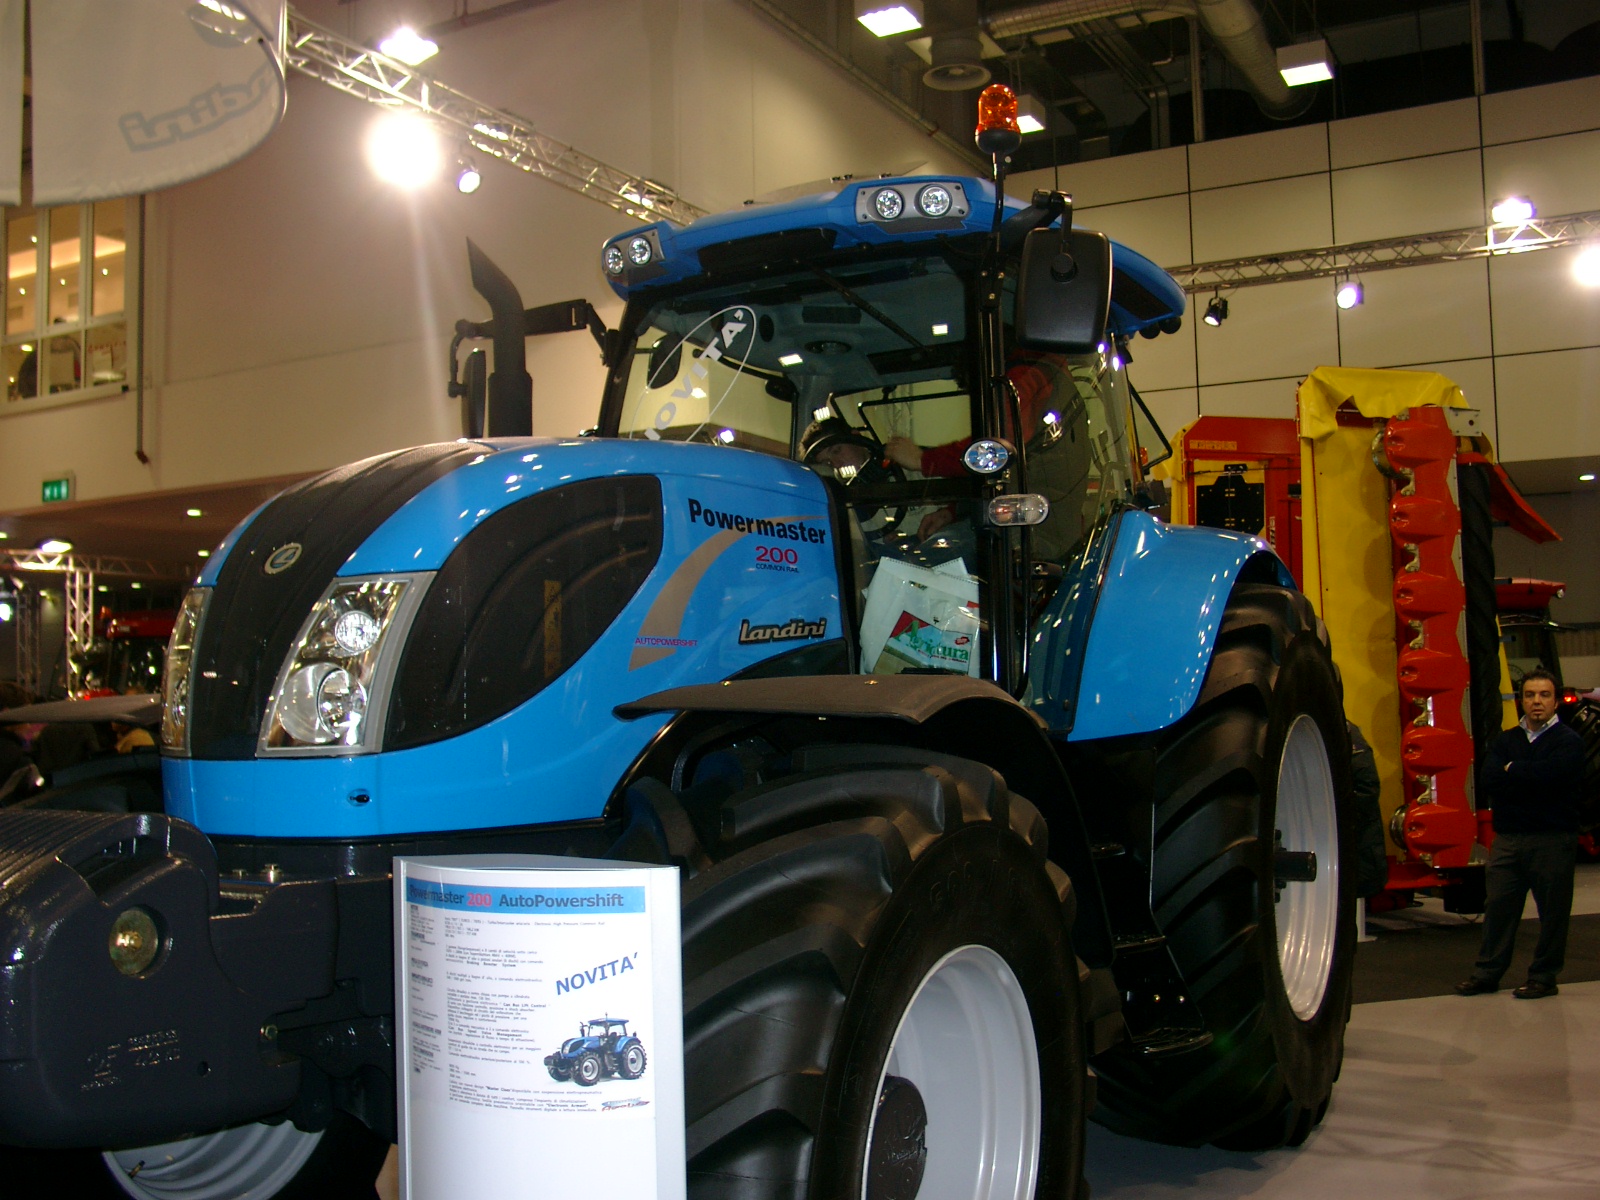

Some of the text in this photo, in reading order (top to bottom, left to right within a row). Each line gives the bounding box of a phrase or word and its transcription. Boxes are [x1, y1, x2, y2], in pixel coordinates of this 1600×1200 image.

[688, 498, 826, 544] Powermaster
[755, 545, 798, 565] 200
[755, 563, 785, 572] COMMON
[635, 637, 698, 646] AUTOPOWERSHIFT
[739, 618, 827, 645] Landini
[409, 884, 624, 908] Powermaster 200 AutoPowershift
